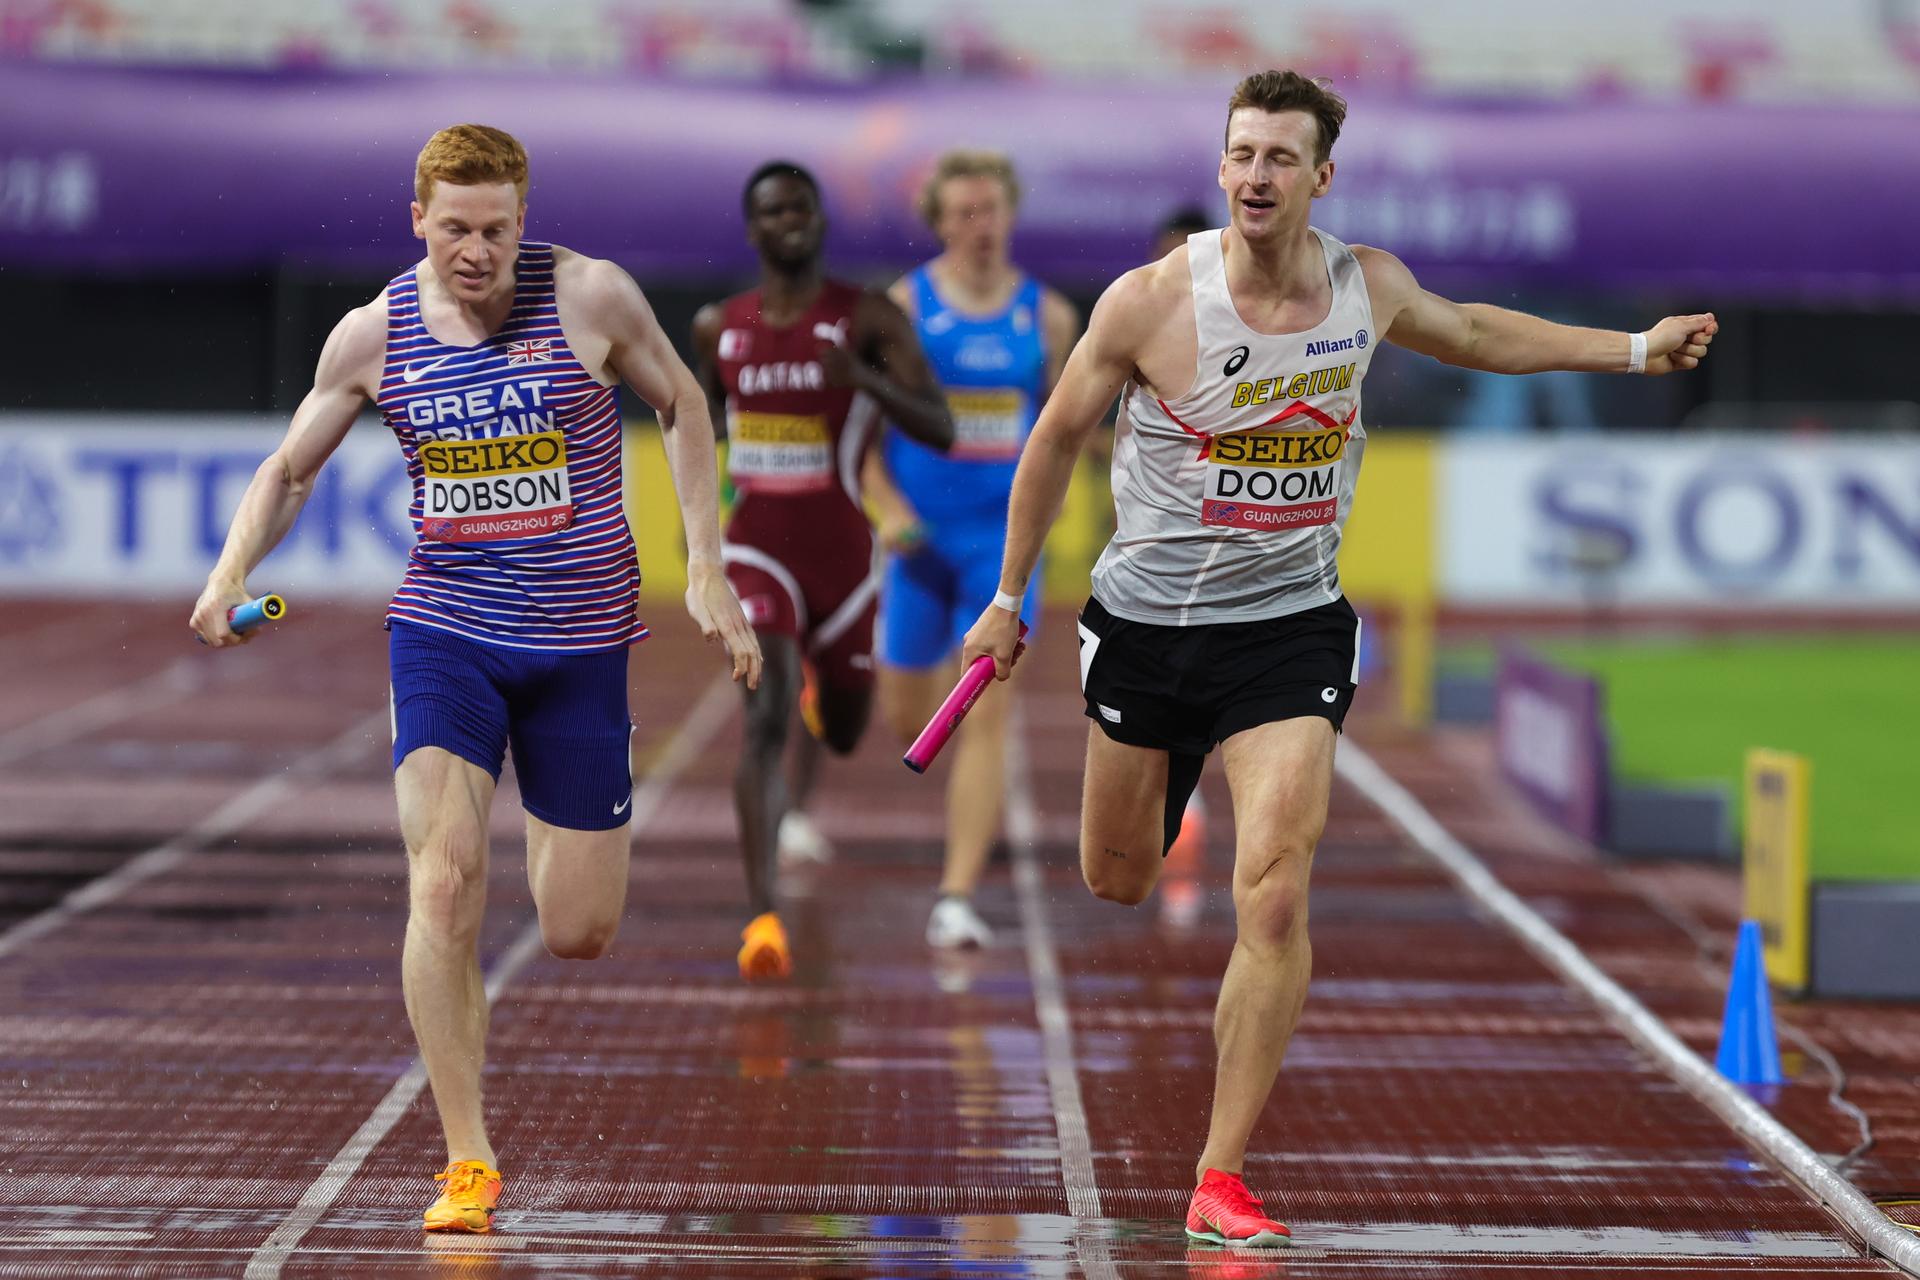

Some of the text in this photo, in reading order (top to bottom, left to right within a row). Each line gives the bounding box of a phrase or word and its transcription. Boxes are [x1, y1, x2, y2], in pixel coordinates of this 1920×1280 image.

[1305, 337, 1353, 357] Allianz
[738, 361, 824, 396] QATAR
[1231, 362, 1356, 409] BELGIUM
[407, 379, 549, 427] GREAT
[423, 437, 559, 474] SEIKO
[1215, 431, 1342, 463] SEIKO
[432, 472, 562, 513] DOBSON
[1216, 466, 1335, 501] DOOM
[460, 512, 567, 535] GUANGZHOU 25
[1242, 504, 1334, 524] GUANGZHOU 25
